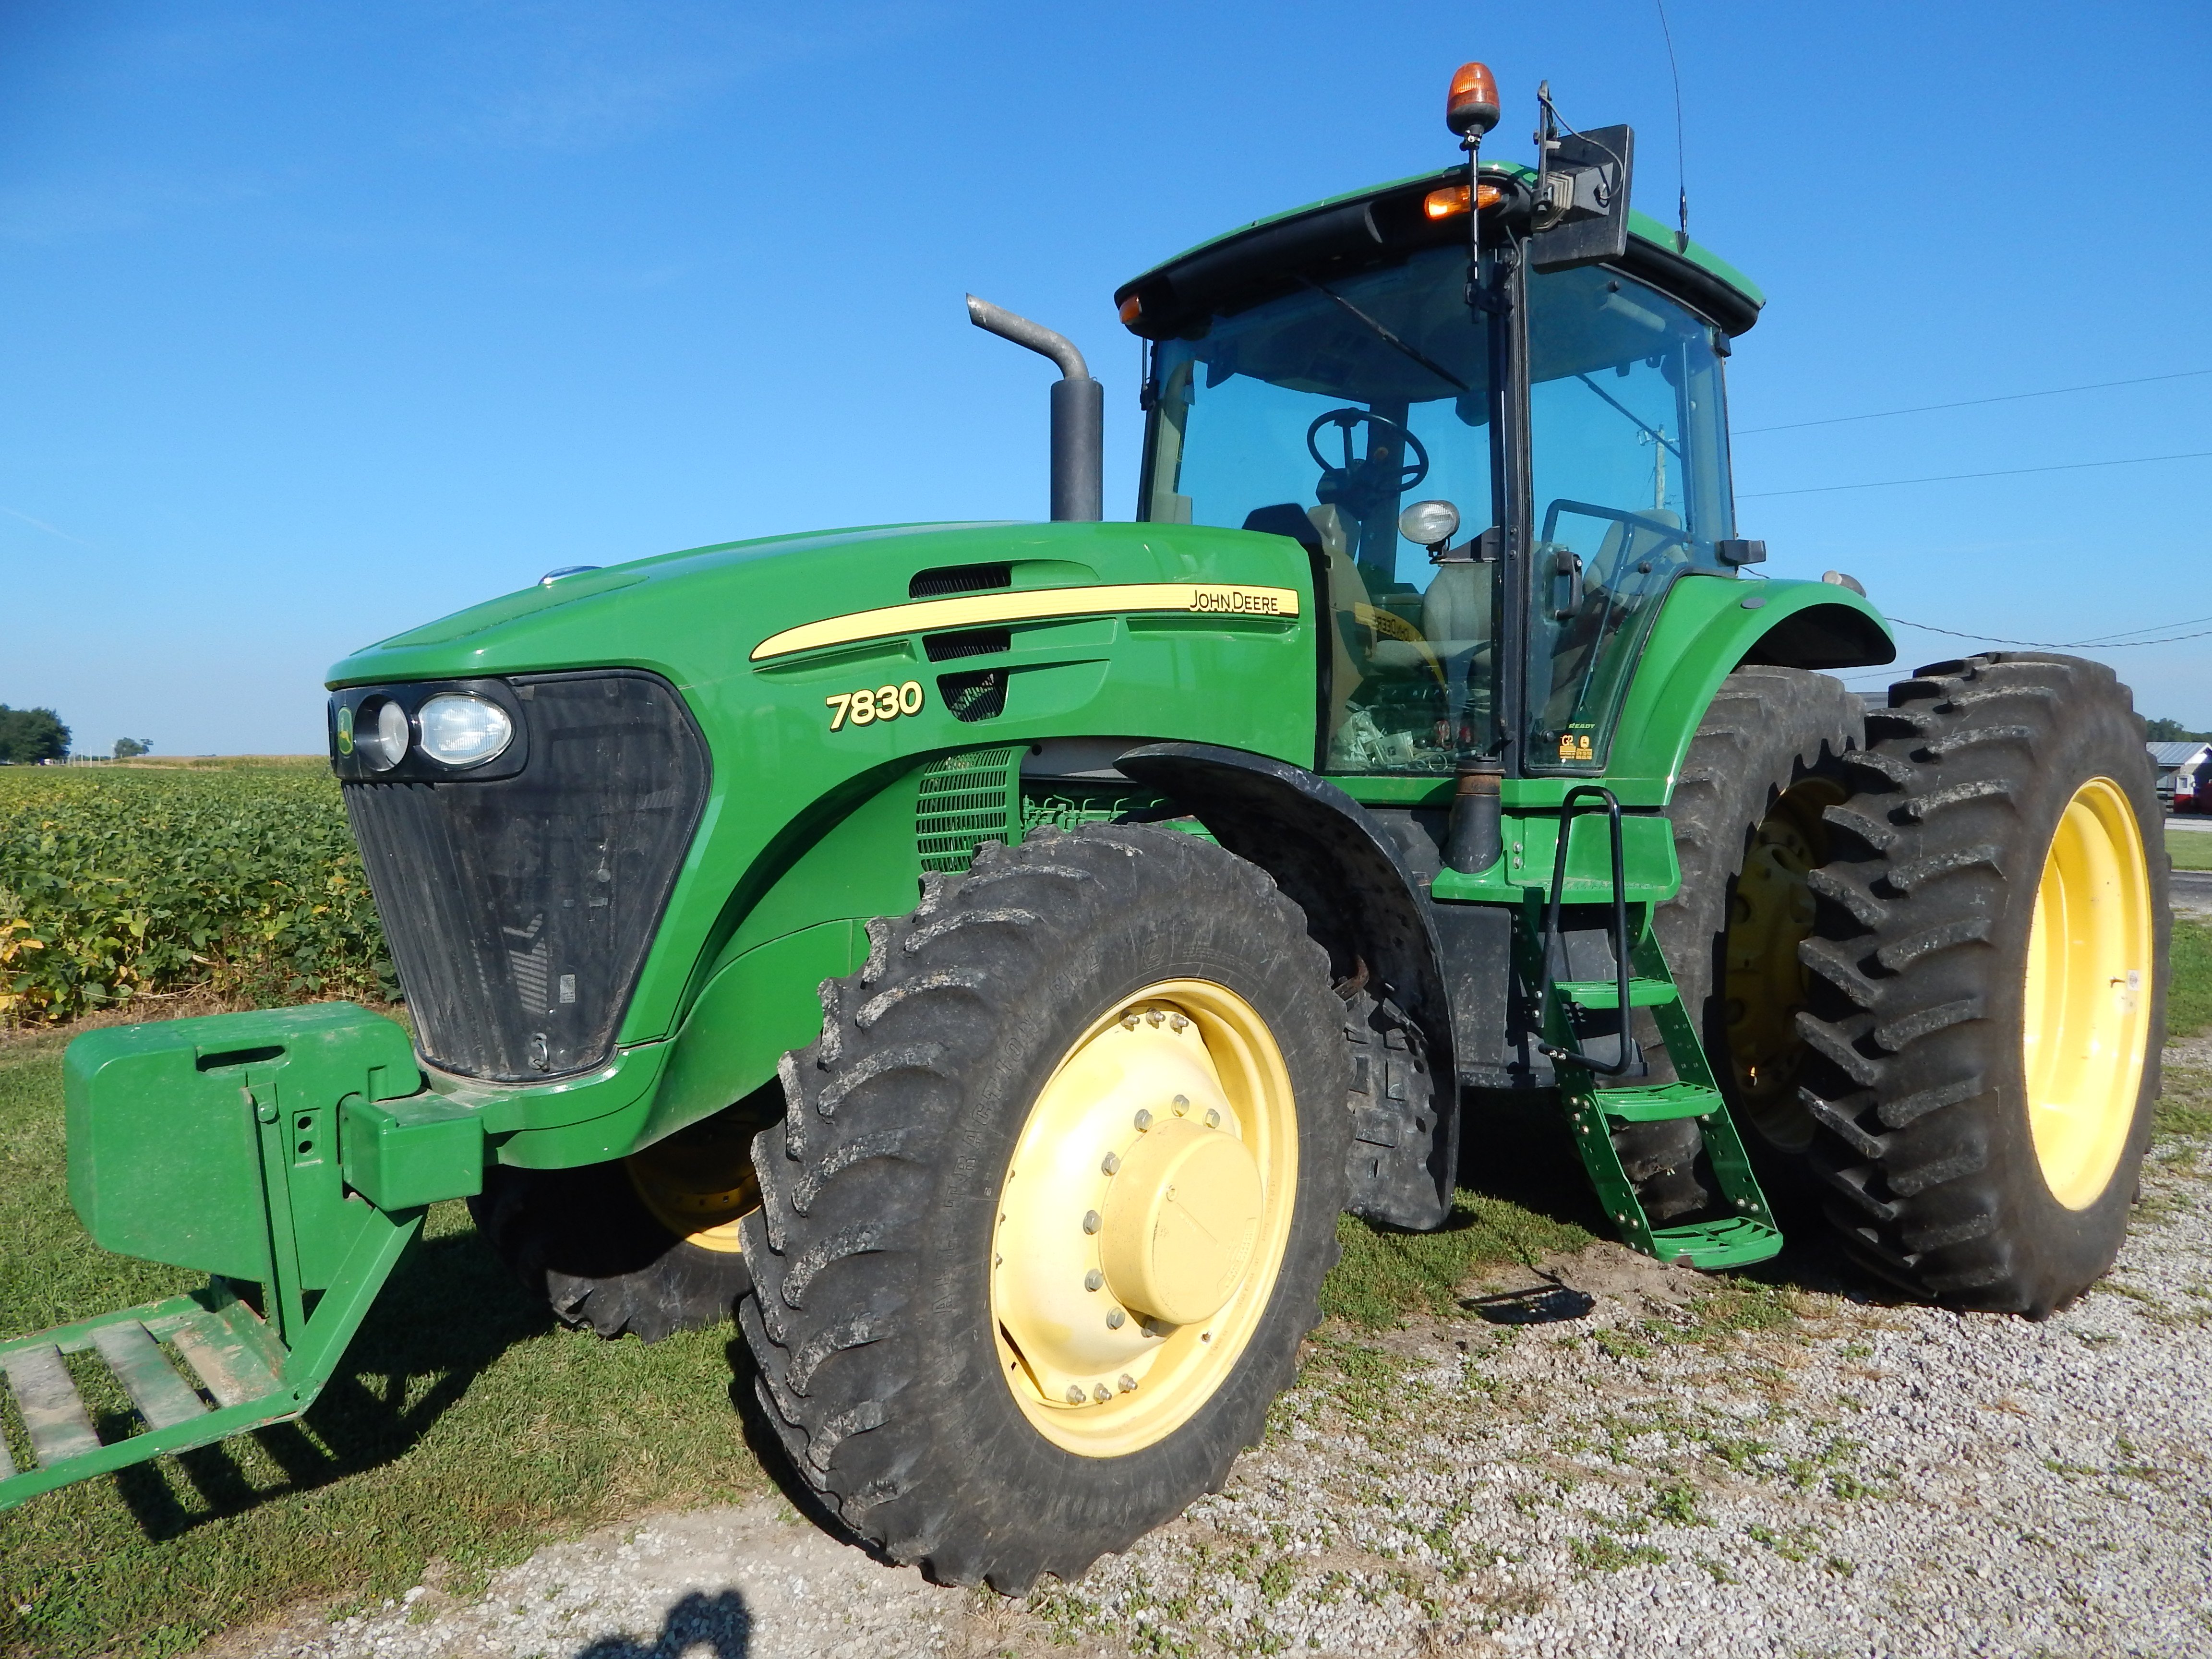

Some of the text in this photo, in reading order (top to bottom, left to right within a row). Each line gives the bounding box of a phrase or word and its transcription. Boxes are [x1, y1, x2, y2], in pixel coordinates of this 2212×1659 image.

[1190, 589, 1278, 612] JOHN DEERE
[825, 680, 925, 733] 7830
[944, 1013, 1040, 1208] TRACTION
